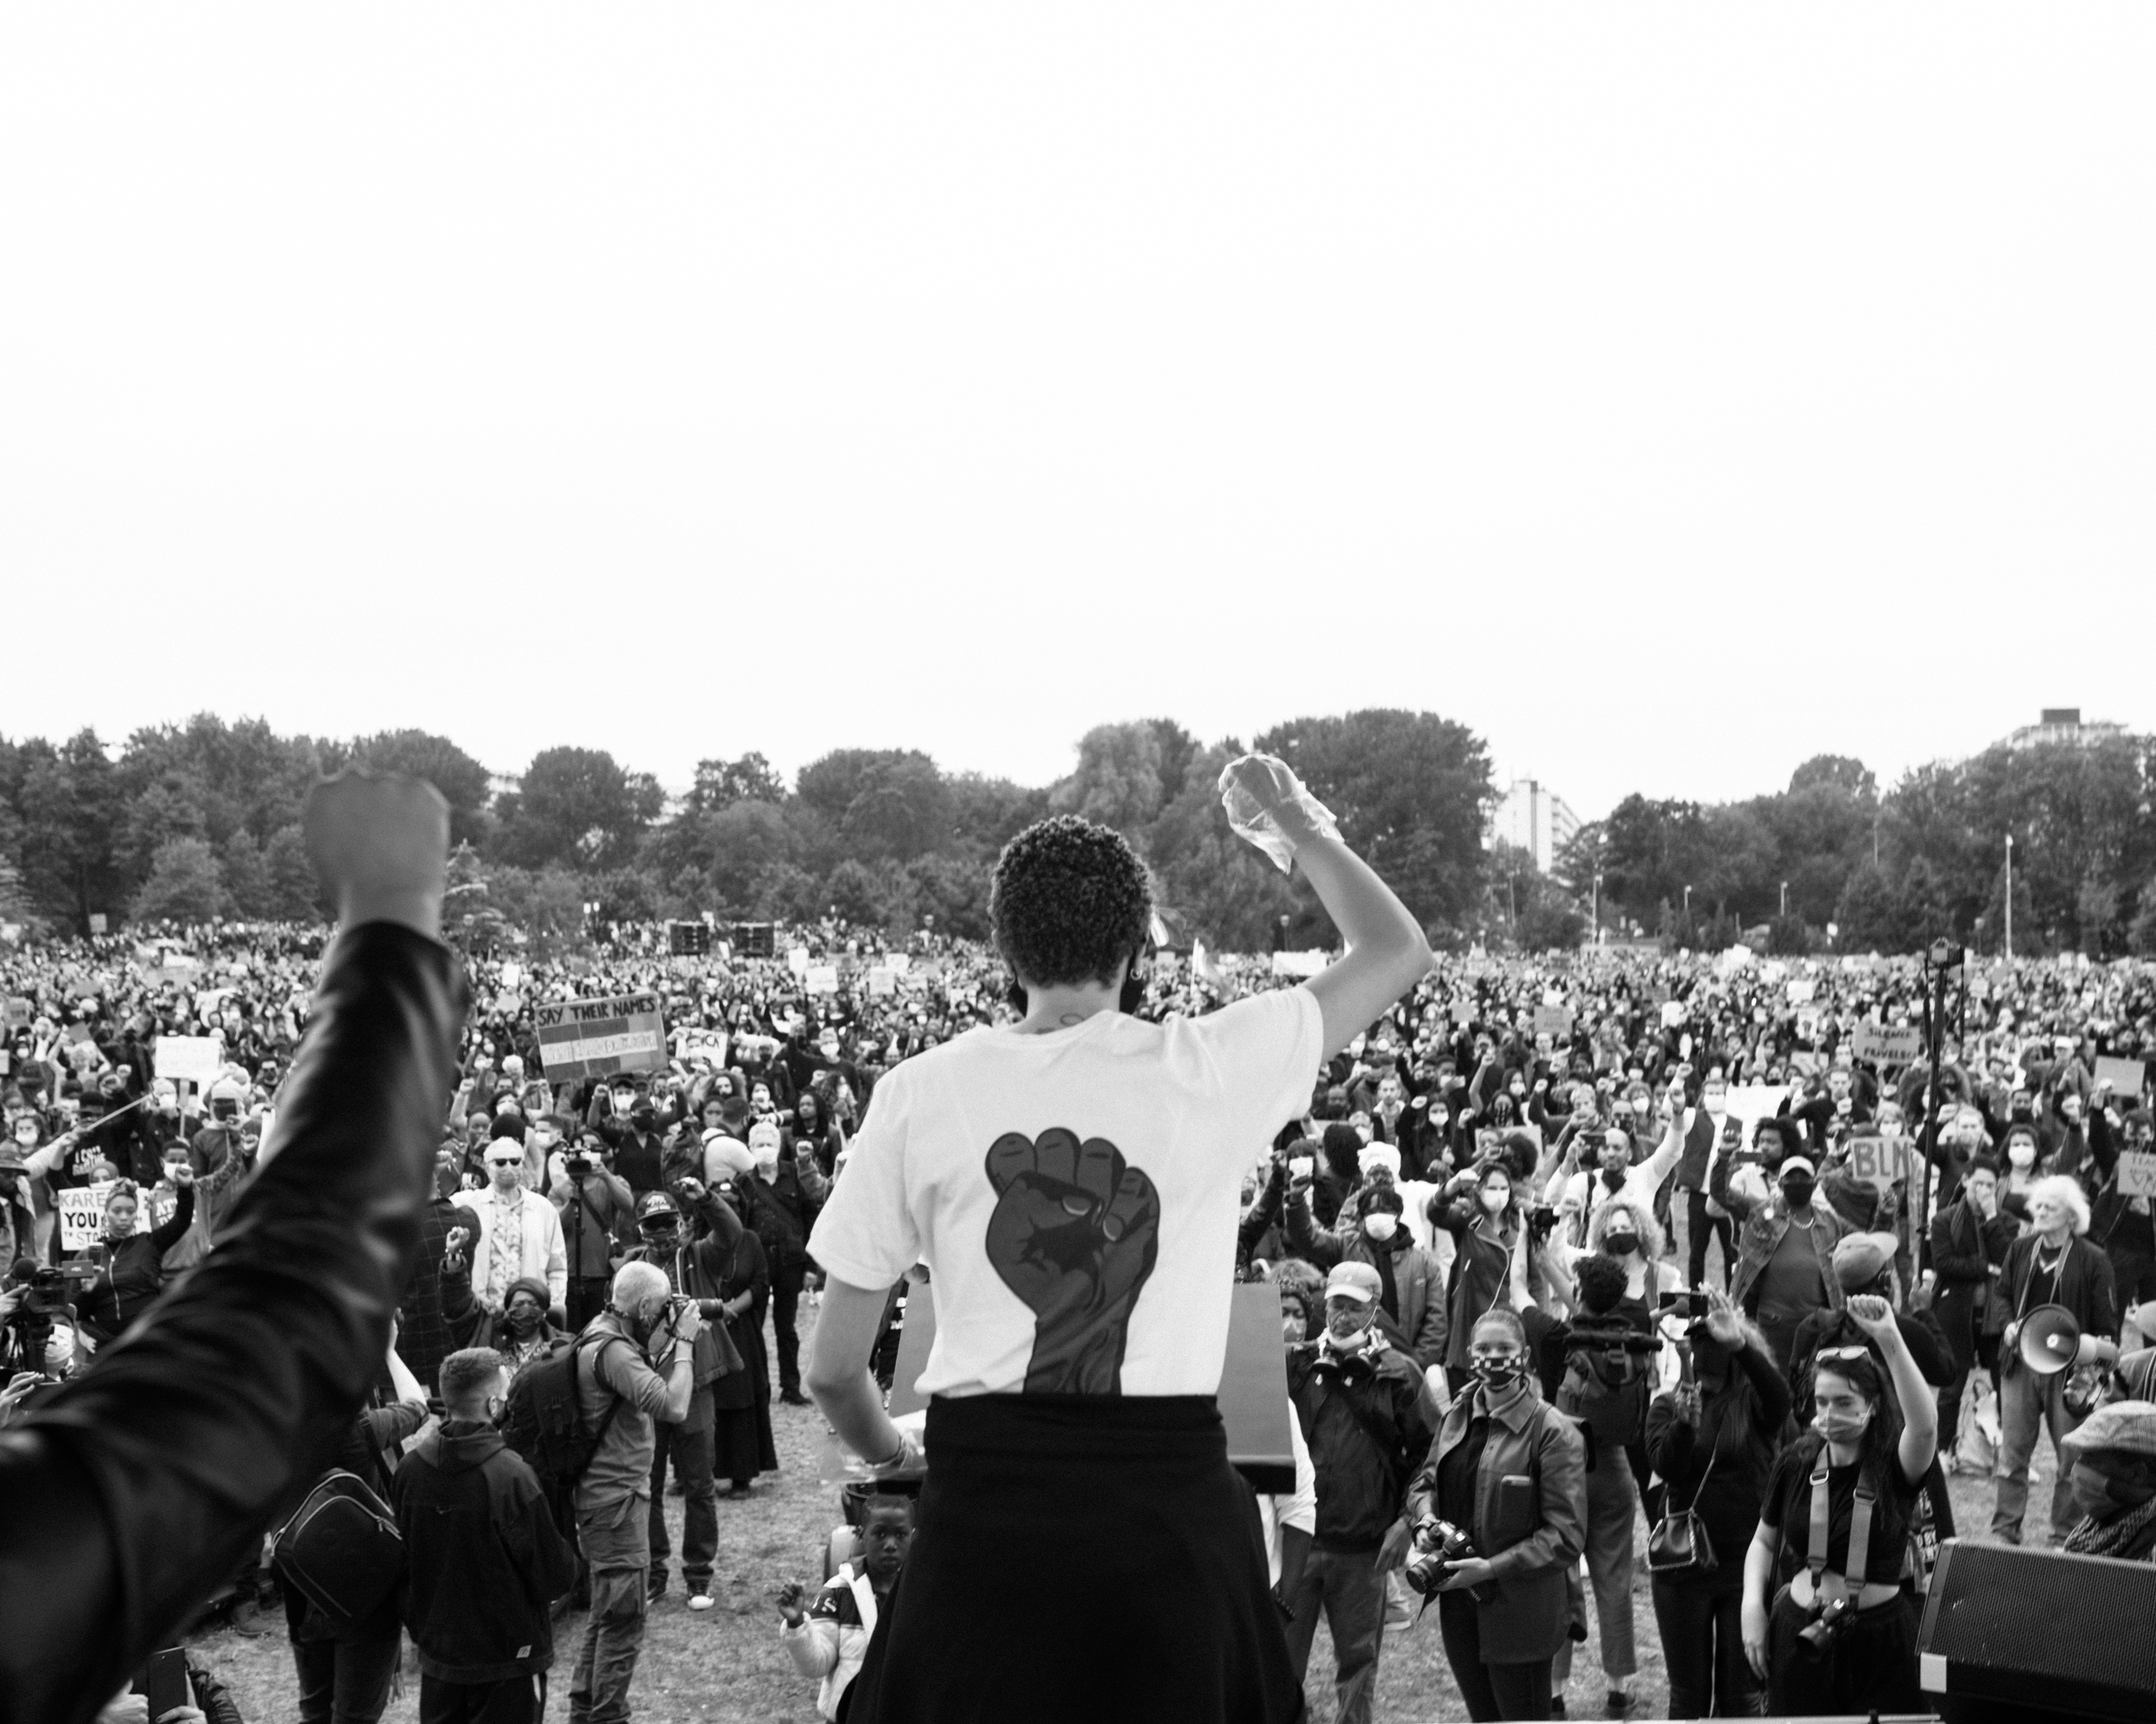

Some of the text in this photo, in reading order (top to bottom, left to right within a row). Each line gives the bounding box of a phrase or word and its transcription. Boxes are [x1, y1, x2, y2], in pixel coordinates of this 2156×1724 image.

[539, 996, 655, 1026] SAY THEIR NAMES
[1853, 1141, 1910, 1179] BLM
[58, 1191, 106, 1208] KARE
[65, 1212, 97, 1228] YOU
